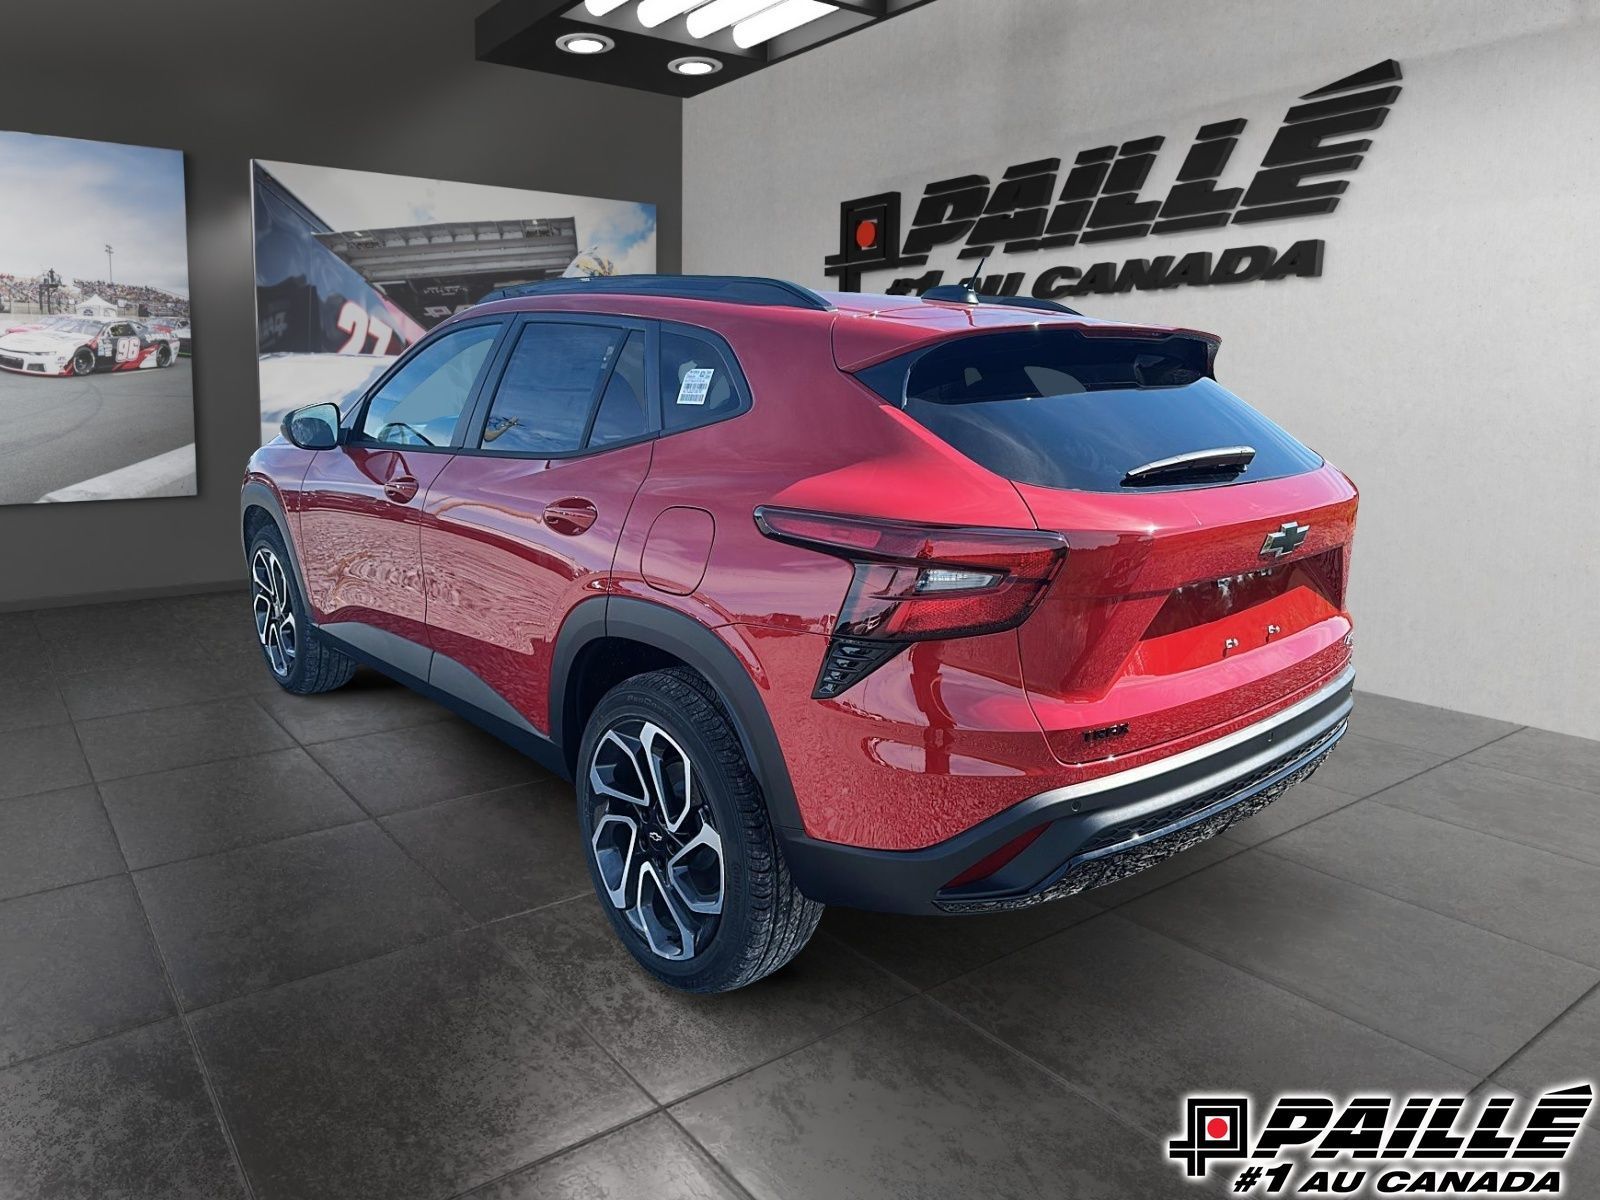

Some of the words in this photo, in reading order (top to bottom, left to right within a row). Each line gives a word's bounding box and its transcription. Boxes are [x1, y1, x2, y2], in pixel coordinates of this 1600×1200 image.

[900, 59, 1403, 266] PAILLÉ
[1032, 239, 1325, 299] CANADA
[116, 337, 140, 363] 96
